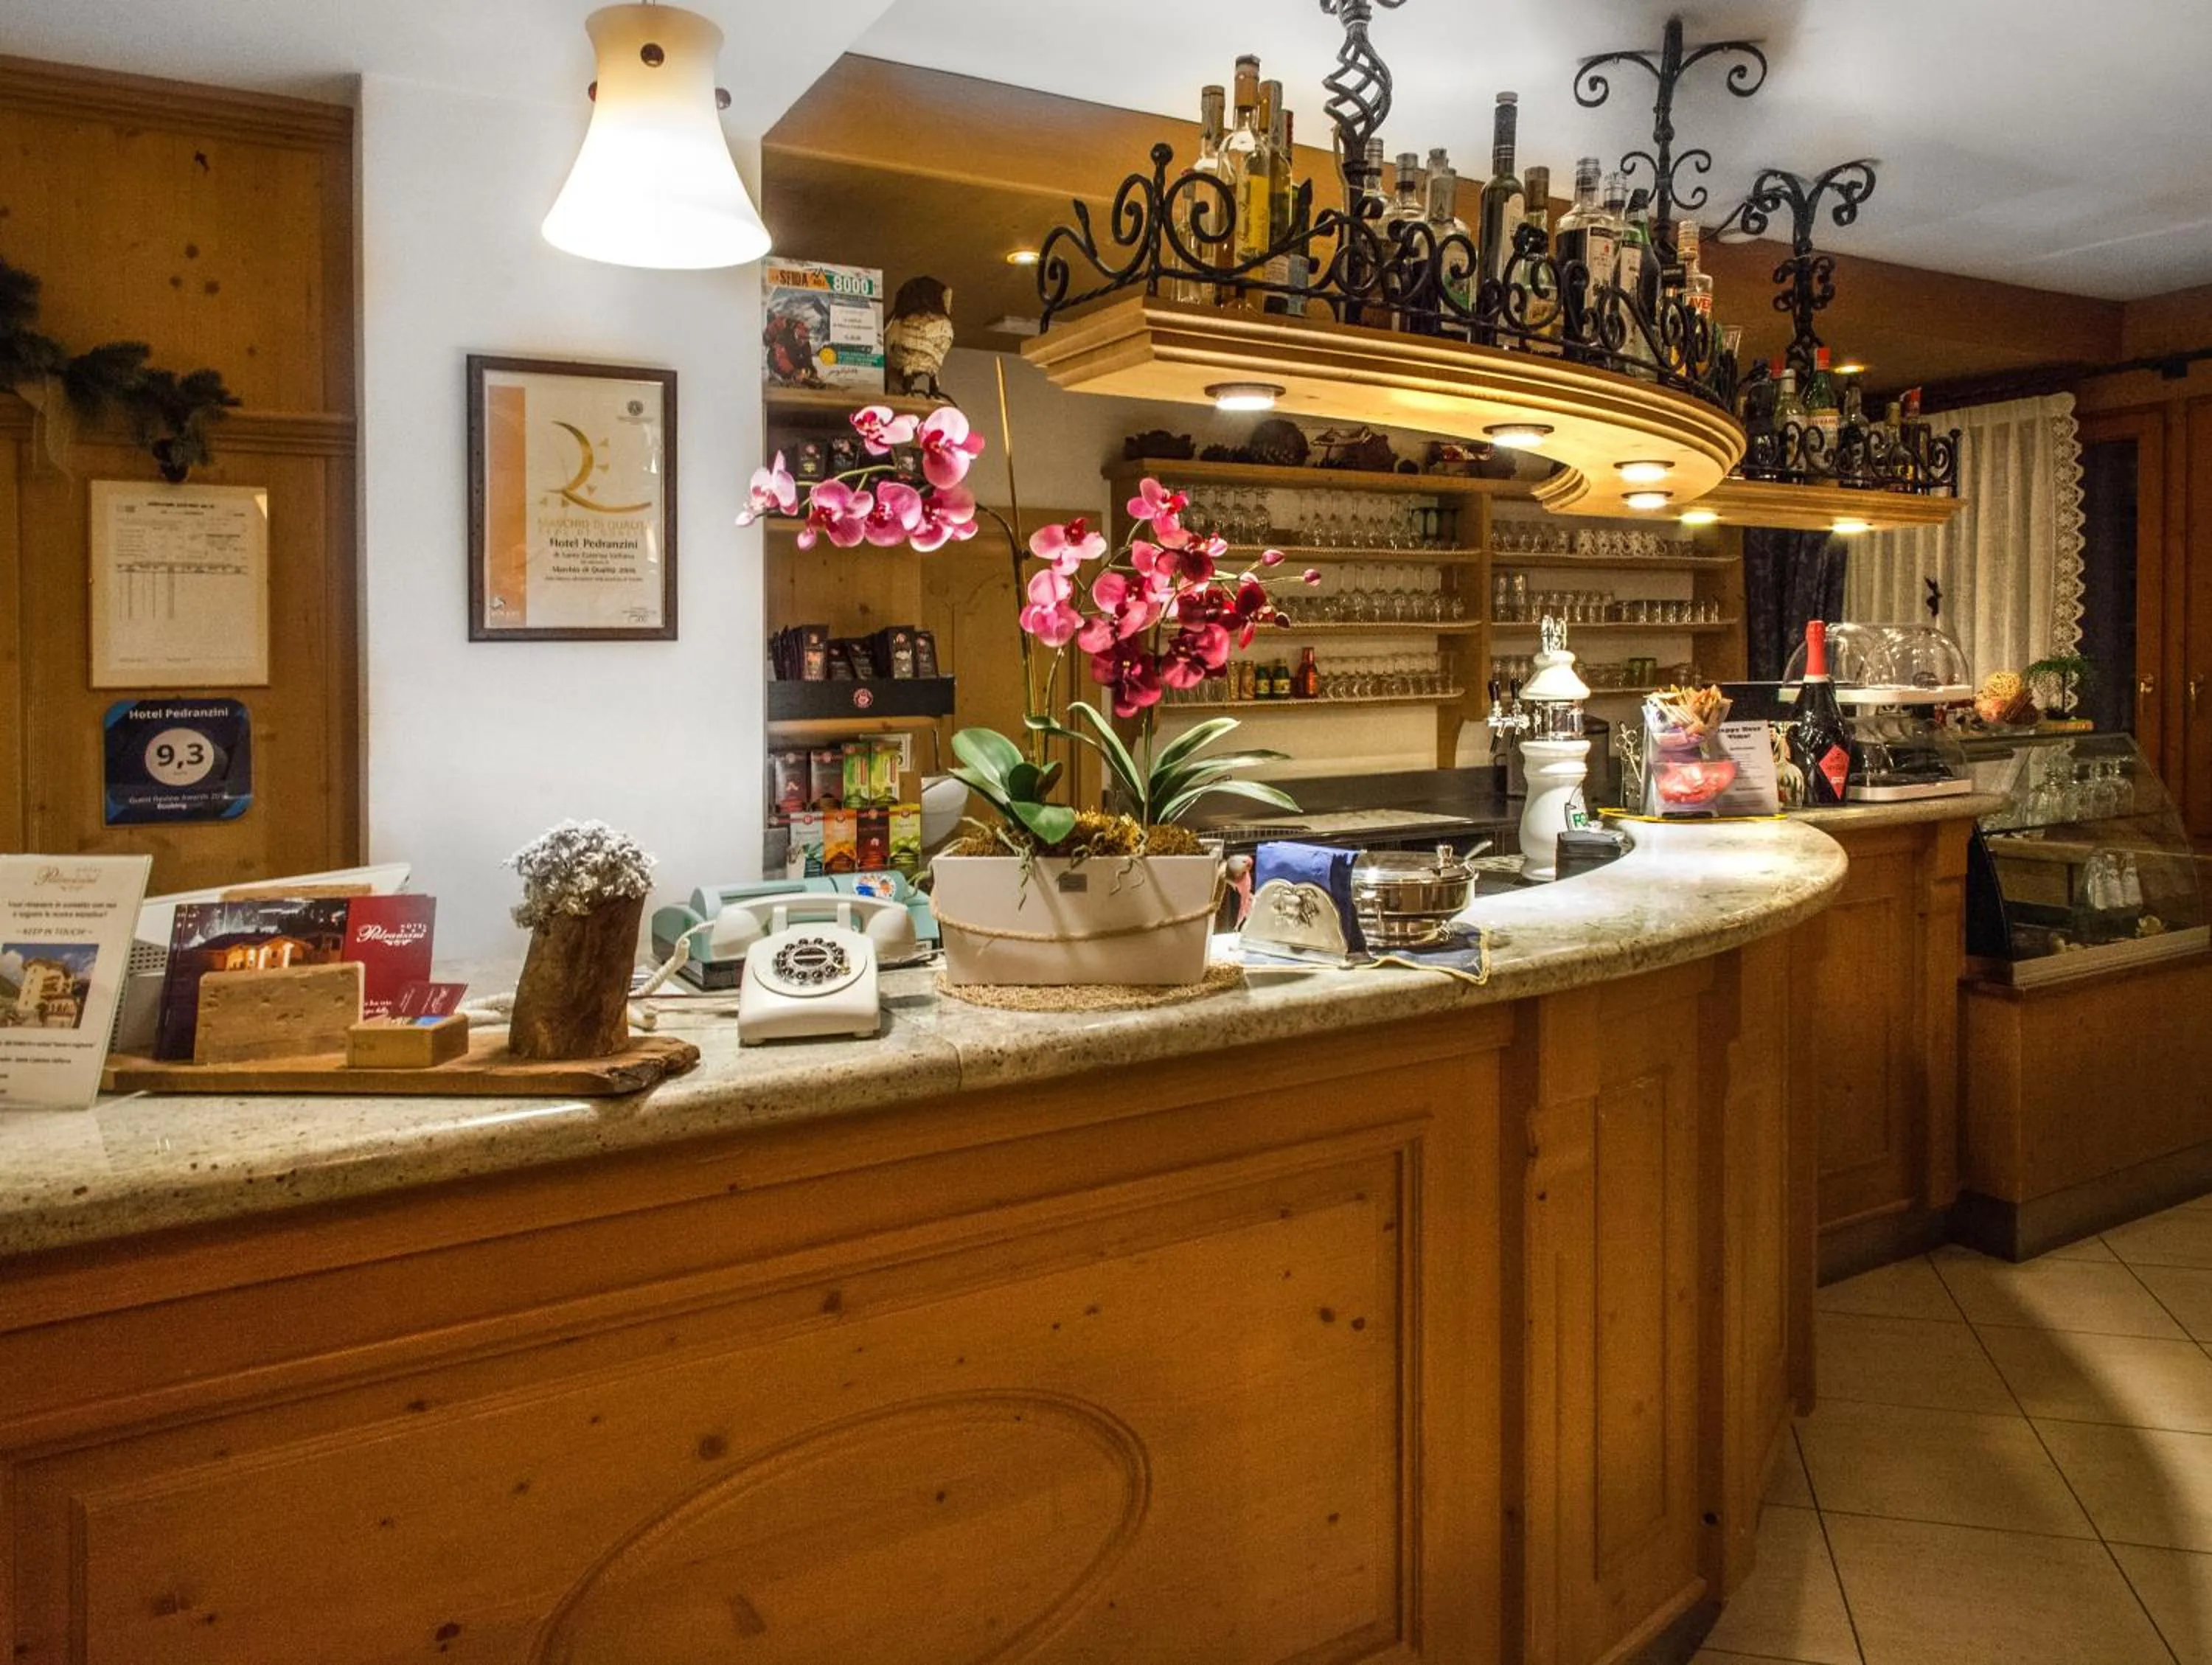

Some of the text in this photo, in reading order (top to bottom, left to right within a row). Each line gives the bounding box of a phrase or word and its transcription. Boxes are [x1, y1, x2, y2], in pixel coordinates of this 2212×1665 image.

[833, 275, 869, 294] 8000
[549, 538, 638, 549] Hotel Pedranzini
[129, 707, 229, 720] Hotel Pedranzini
[156, 743, 205, 769] 9,3
